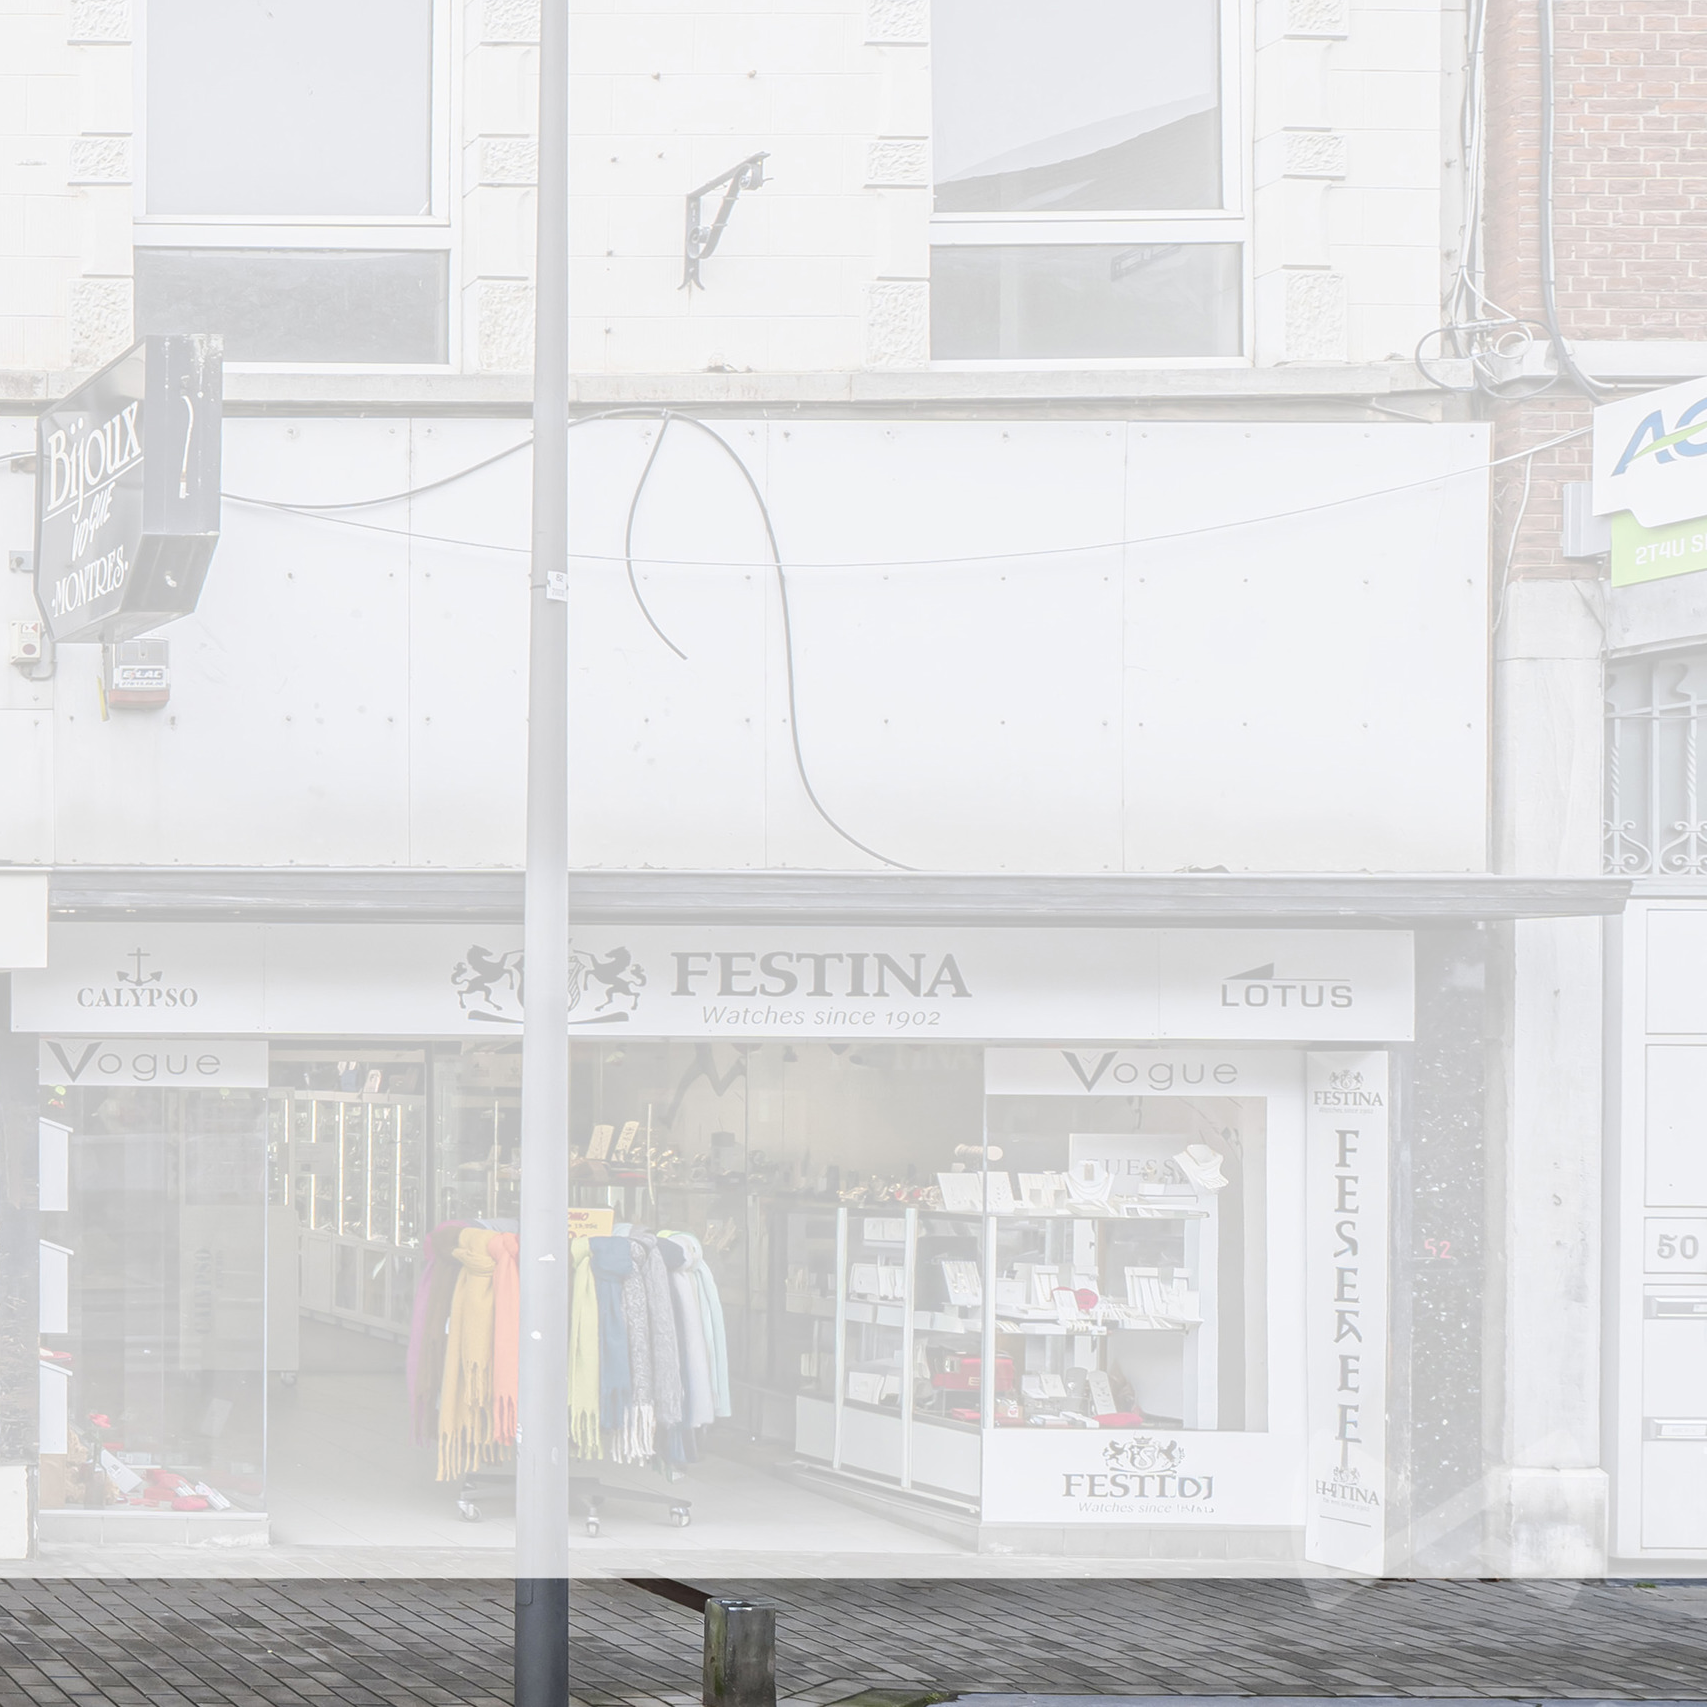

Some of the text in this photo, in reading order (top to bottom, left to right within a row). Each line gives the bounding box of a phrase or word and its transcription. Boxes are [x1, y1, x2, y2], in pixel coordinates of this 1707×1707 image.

[47, 401, 141, 524] Bijoux
[1635, 539, 1685, 566] 2T4U
[670, 950, 973, 1000] FESTINA
[77, 987, 199, 1008] CALYPSO
[1220, 983, 1354, 1010] LOTUS
[701, 1003, 942, 1030] Watches since 1902
[45, 1040, 221, 1083] Vogue
[1061, 1049, 1239, 1093] Vogue
[1313, 1090, 1384, 1106] FESTINA
[1423, 1237, 1452, 1260] 52
[1656, 1234, 1700, 1260] 50
[1078, 1500, 1134, 1514] Watches
[1138, 1501, 1172, 1514] since
